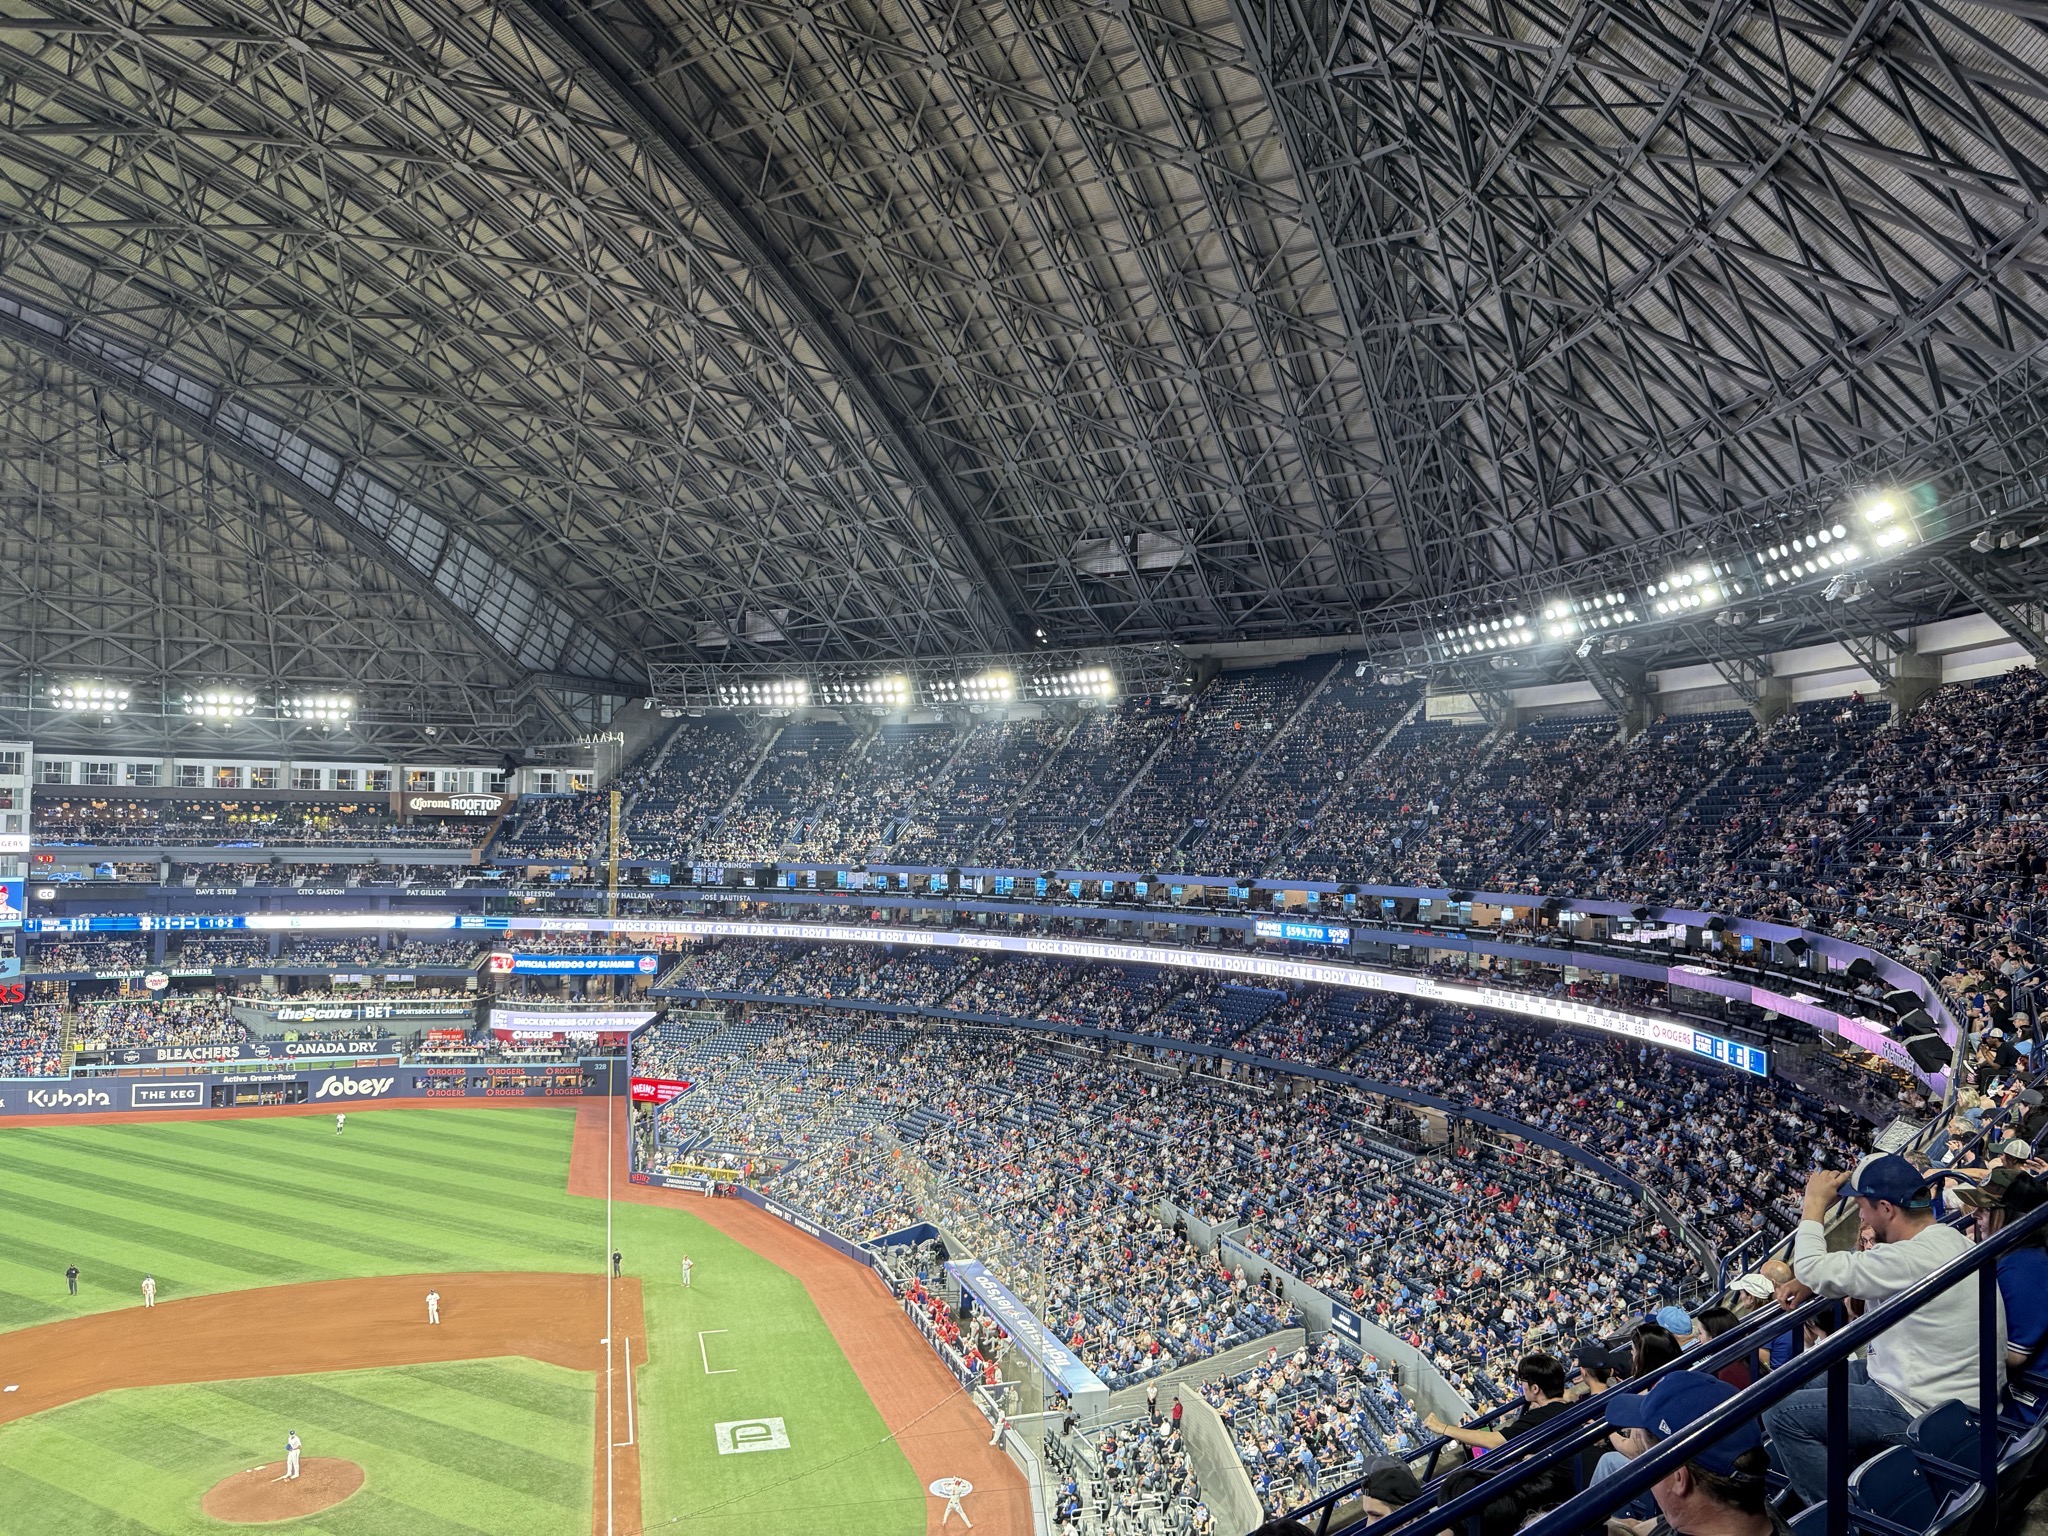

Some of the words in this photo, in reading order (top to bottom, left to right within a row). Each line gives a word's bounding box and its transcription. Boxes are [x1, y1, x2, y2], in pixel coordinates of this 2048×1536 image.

[410, 797, 450, 811] Corona
[450, 799, 502, 810] ROOFTOP
[297, 888, 314, 896] CITO
[316, 888, 345, 896] GASTON
[420, 889, 447, 897] GILLICK
[524, 890, 556, 898] BEESTON
[700, 893, 718, 901] JOSÉ
[720, 894, 752, 902] BAUTISTA
[613, 922, 647, 932] KNOCK
[648, 922, 693, 933] DRYNESS
[694, 924, 714, 933] OUT
[715, 924, 729, 933] OF
[730, 925, 748, 934] THE
[750, 925, 775, 935] PARK
[776, 927, 800, 936] WITH
[801, 928, 829, 938] DOVE
[880, 931, 905, 942] BODY
[907, 932, 934, 943] WASH
[515, 960, 547, 969] OFFICIAL
[585, 960, 598, 969] OF
[598, 960, 635, 969] SUMMER
[1026, 940, 1060, 952] KNOCK
[1107, 947, 1128, 958] OUT
[1130, 949, 1145, 960] OF
[1146, 950, 1166, 962] THE
[1168, 952, 1195, 965] PARK
[1196, 954, 1223, 968] WITH
[1225, 957, 1255, 972] DOVE
[1316, 967, 1346, 982] BODY
[1349, 972, 1382, 988] WASH
[95, 970, 128, 979] CANADA
[129, 969, 146, 977] DRY
[171, 968, 213, 976] BLEACHERS
[277, 1007, 353, 1020] theScore
[365, 1006, 393, 1018] BET
[521, 1031, 554, 1039] ROGERS
[1661, 1028, 1691, 1045] ROGERS
[285, 1042, 347, 1055] CANADA
[157, 1046, 240, 1061] BLEACHERS
[436, 1068, 466, 1076] ROGERS
[554, 1067, 584, 1075] ROGERS
[222, 1075, 248, 1083] Active
[315, 1075, 395, 1099] Sobeys
[632, 1083, 656, 1095] HEINZ
[140, 1090, 166, 1100] THE
[170, 1090, 196, 1099] KEG
[435, 1089, 466, 1097] ROGERS
[495, 1088, 525, 1096] ROGERS
[553, 1088, 583, 1096] ROGERS
[27, 1089, 111, 1108] Kubota
[631, 1174, 651, 1184] HEINZ
